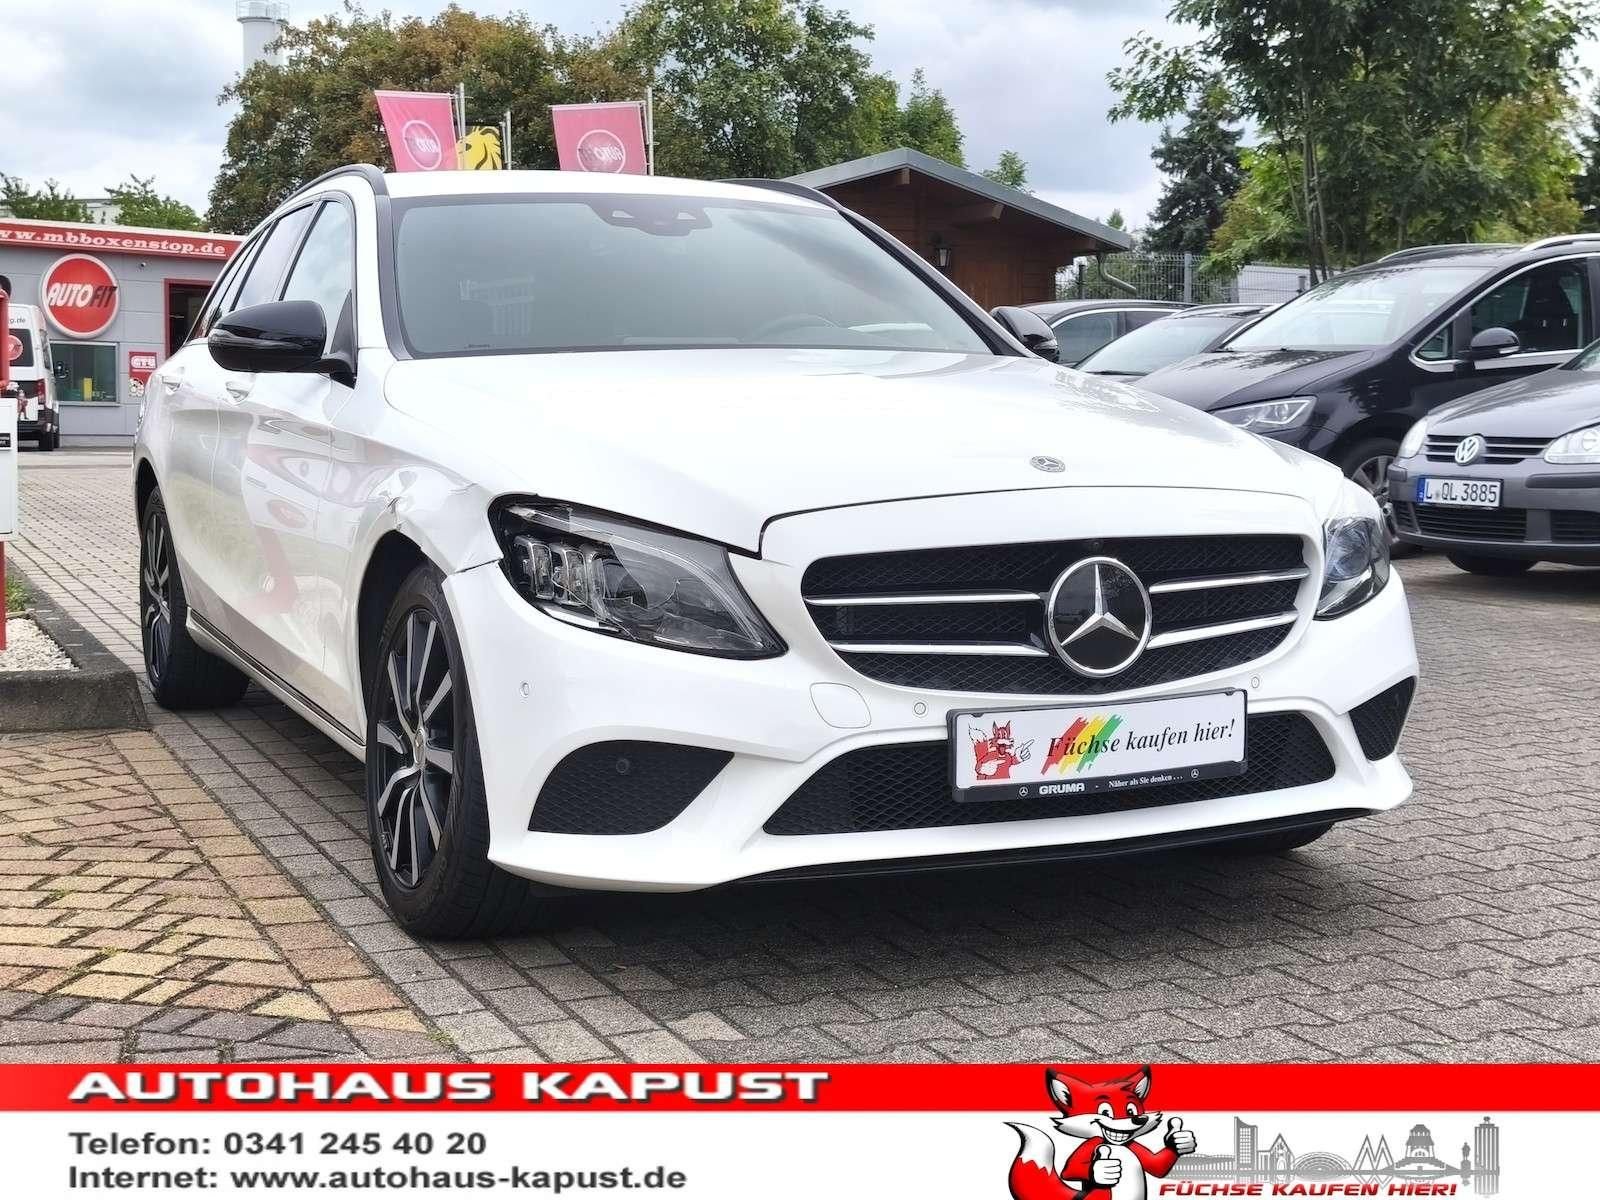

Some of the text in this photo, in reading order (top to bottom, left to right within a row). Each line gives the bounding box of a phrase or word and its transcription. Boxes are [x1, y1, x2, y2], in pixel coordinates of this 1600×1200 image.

[1461, 483, 1497, 503] 3885
[1047, 718, 1235, 757] Füchse kaufen hier!
[1039, 783, 1085, 795] GRUMA
[1130, 778, 1139, 786] als
[1139, 776, 1149, 785] Sie
